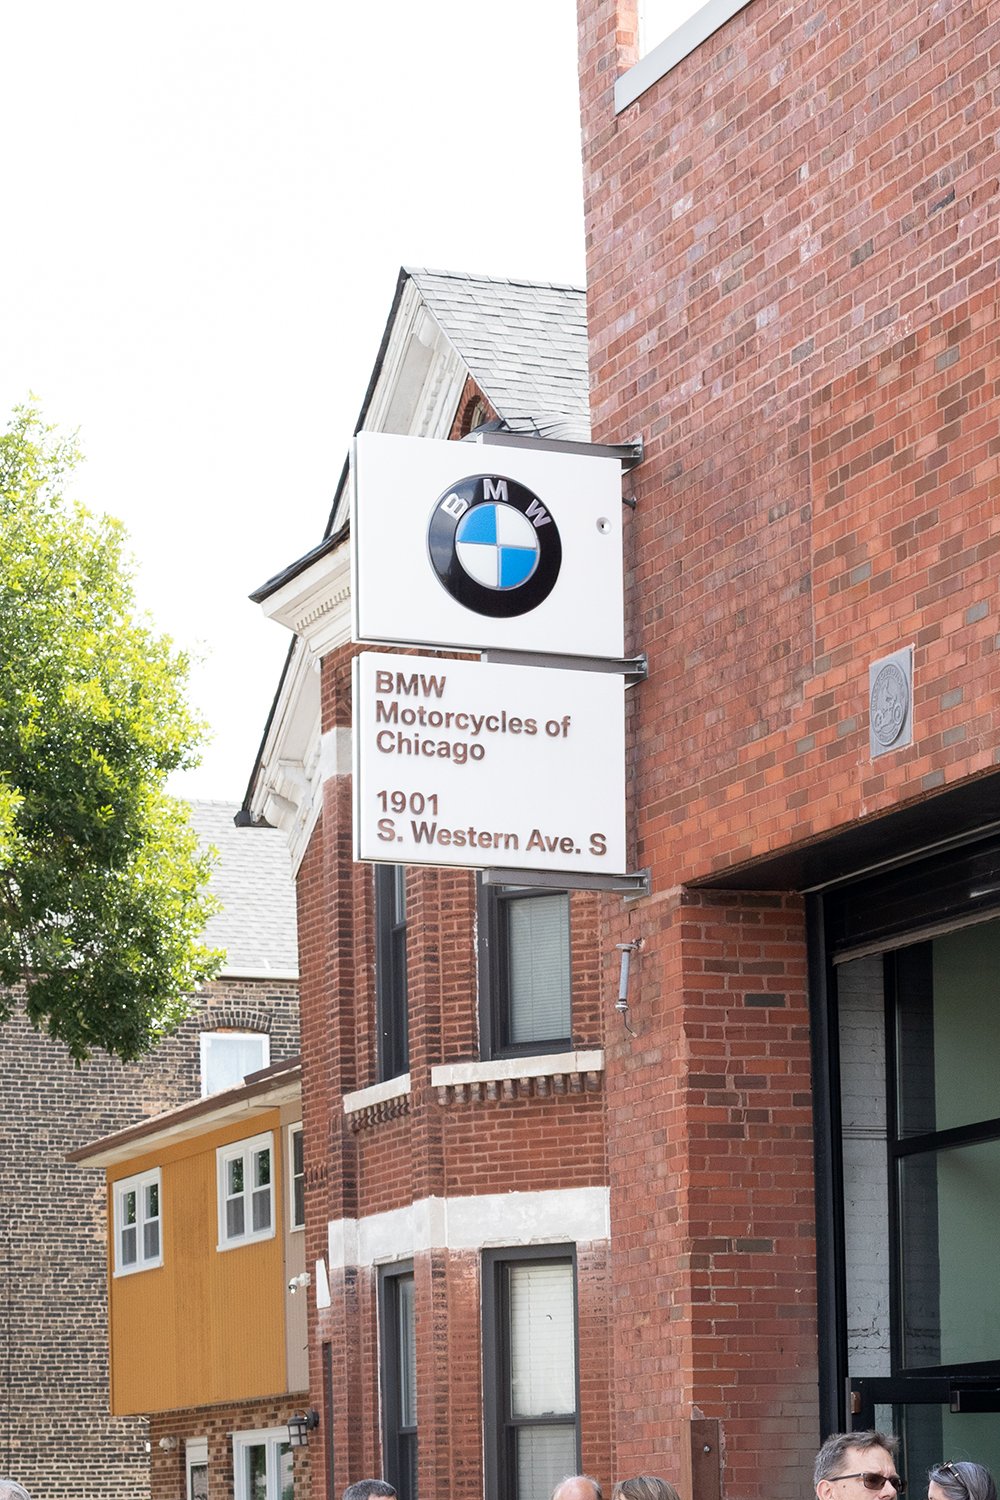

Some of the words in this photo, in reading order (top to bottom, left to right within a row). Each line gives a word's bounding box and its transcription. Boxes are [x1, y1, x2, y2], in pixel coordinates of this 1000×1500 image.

[442, 478, 552, 529] BMW
[375, 670, 447, 699] BMW
[375, 700, 538, 738] Motorcycles
[544, 715, 571, 738] of
[376, 730, 486, 765] Chicago
[376, 790, 439, 816] 1901
[376, 818, 403, 843] S.
[411, 821, 519, 851] Western
[526, 829, 582, 855] Ave.
[588, 833, 608, 856] S
